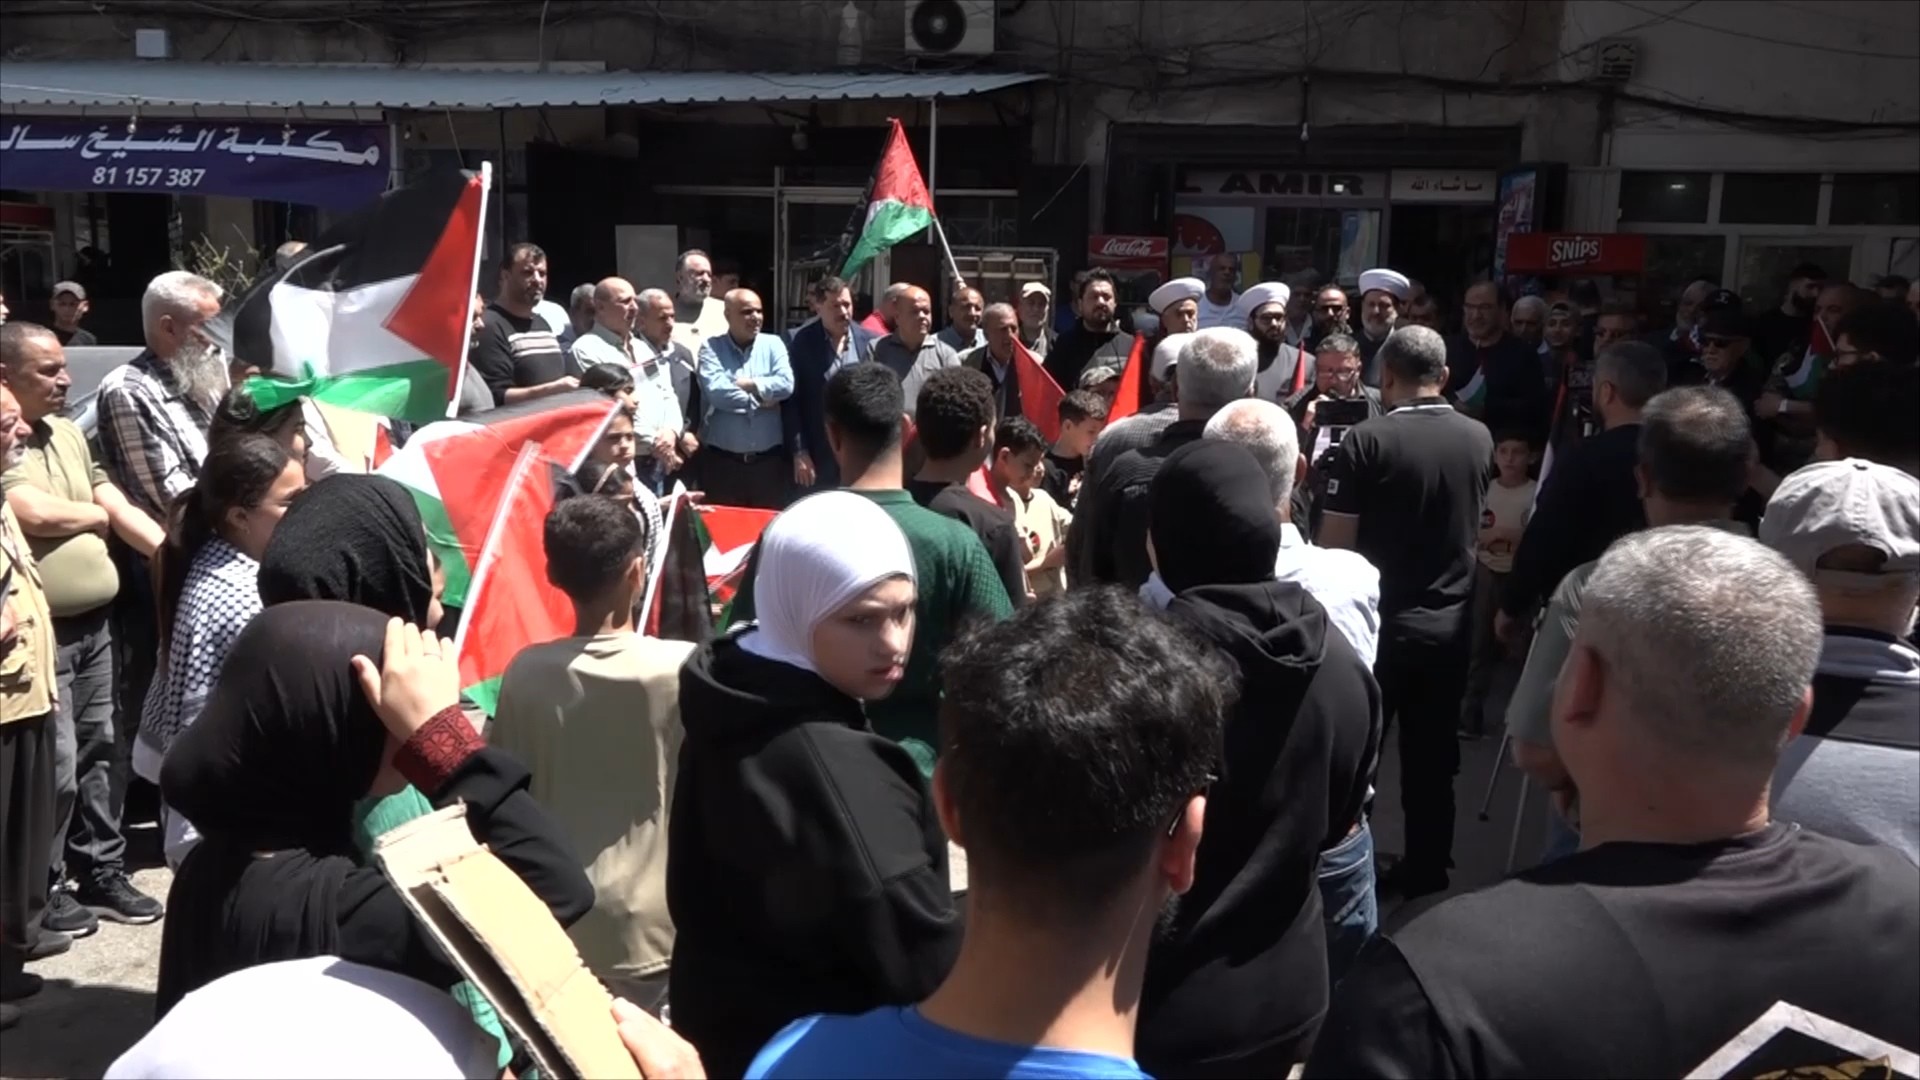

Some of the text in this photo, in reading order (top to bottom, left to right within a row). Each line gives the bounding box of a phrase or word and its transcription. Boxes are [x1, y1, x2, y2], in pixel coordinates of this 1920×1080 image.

[80, 124, 217, 159] الشيخ
[217, 124, 380, 167] مكتبة
[92, 166, 207, 188] 81 157 387
[1219, 172, 1364, 196] AMIR
[1411, 175, 1483, 192] ما شاء الله
